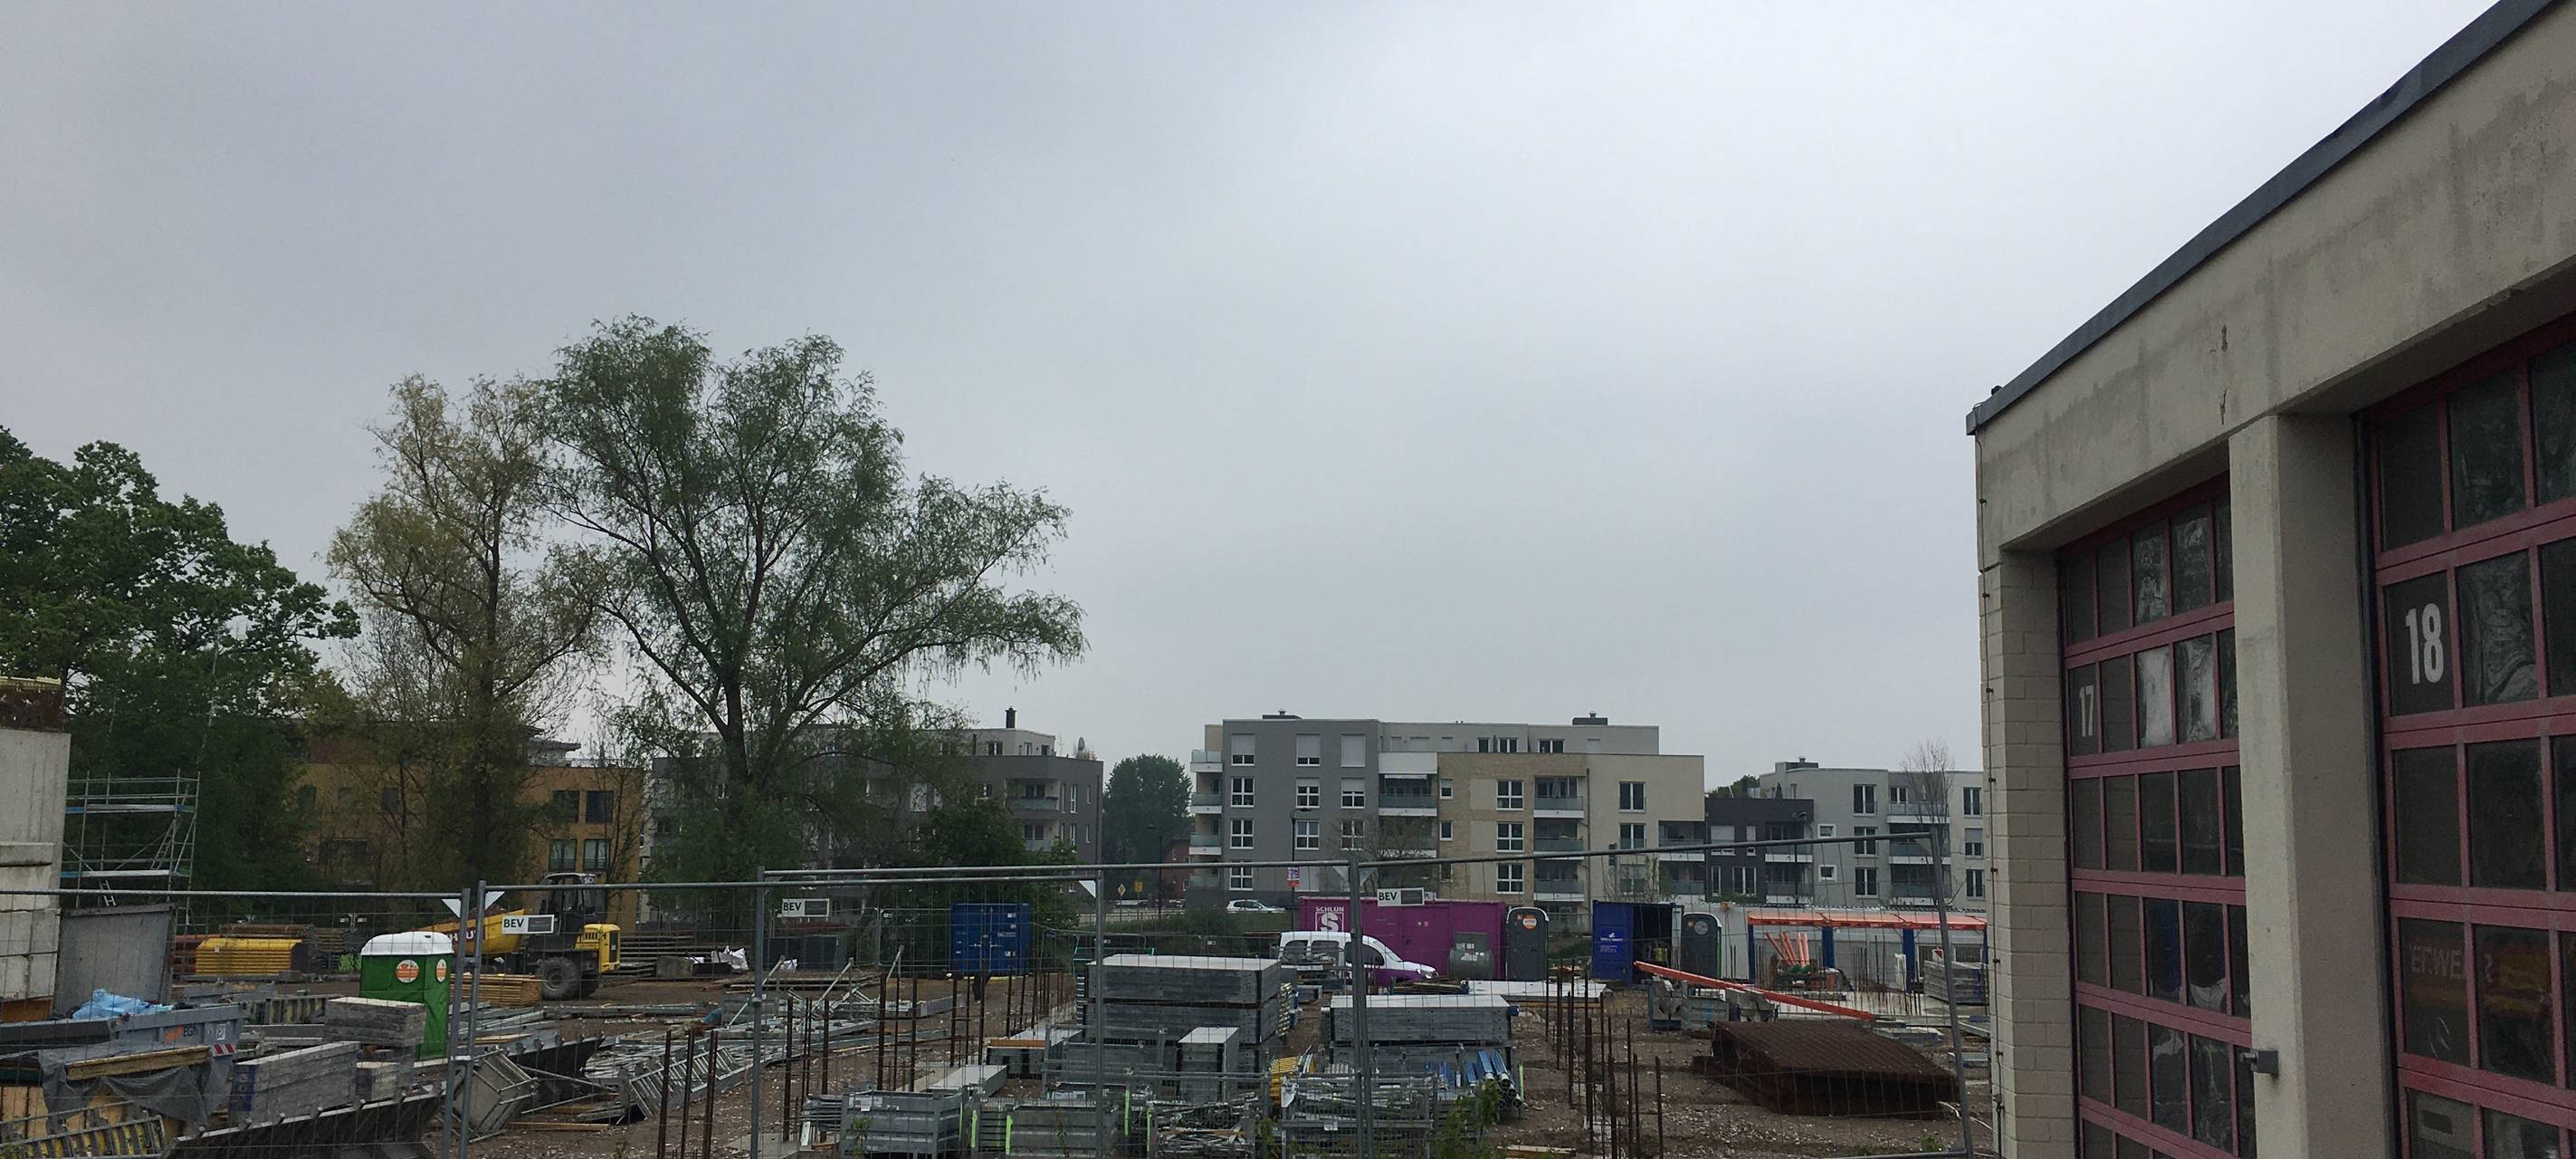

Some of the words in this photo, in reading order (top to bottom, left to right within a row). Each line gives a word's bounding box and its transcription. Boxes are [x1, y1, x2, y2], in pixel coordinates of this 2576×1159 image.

[2404, 602, 2445, 685] 18
[2078, 685, 2095, 738] 17
[1378, 892, 1398, 901] BEV
[783, 902, 802, 911] BEV
[503, 918, 524, 928] BEV
